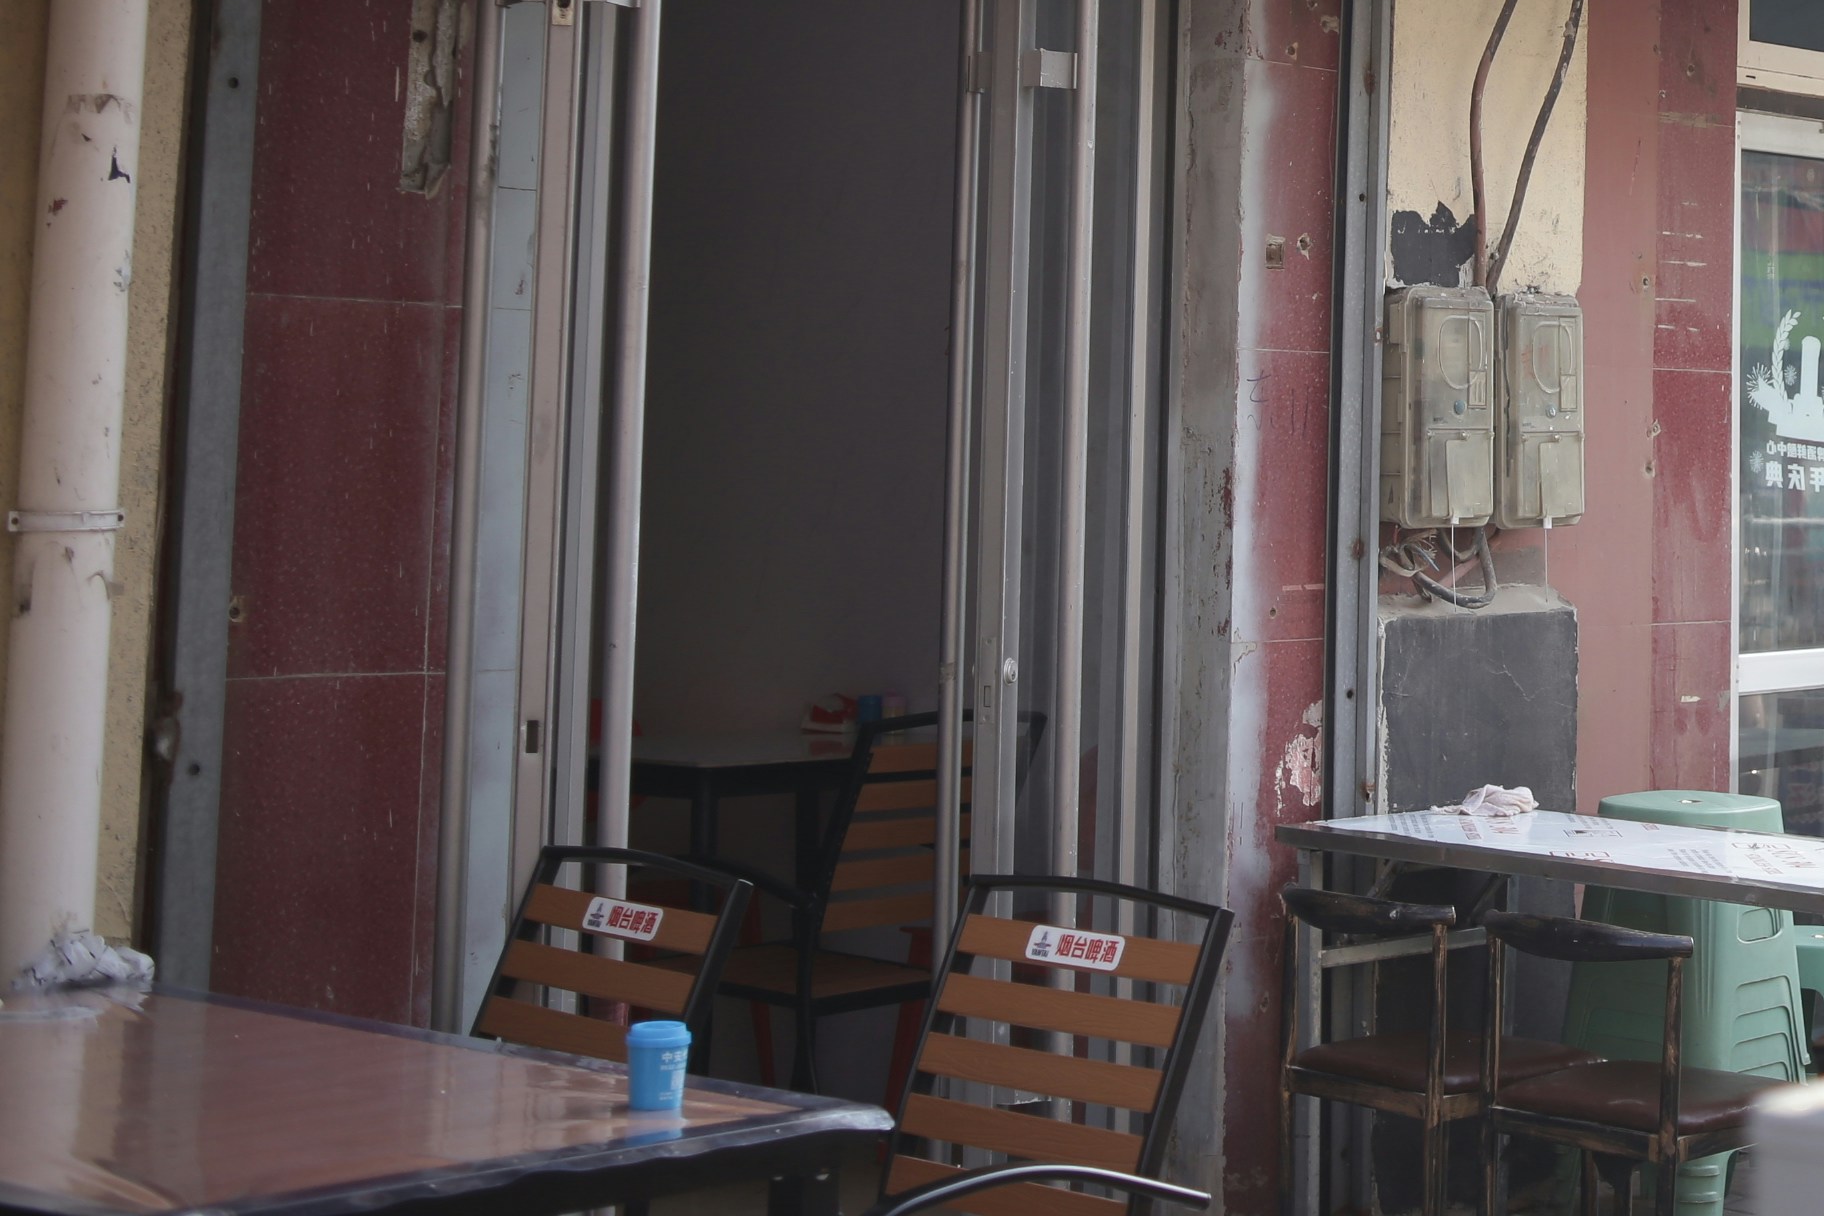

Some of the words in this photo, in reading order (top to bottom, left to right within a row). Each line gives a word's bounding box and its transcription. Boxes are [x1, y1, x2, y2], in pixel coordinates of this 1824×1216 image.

[606, 905, 659, 935] 烟台啤酒
[1055, 933, 1120, 964] 烟台啤酒
